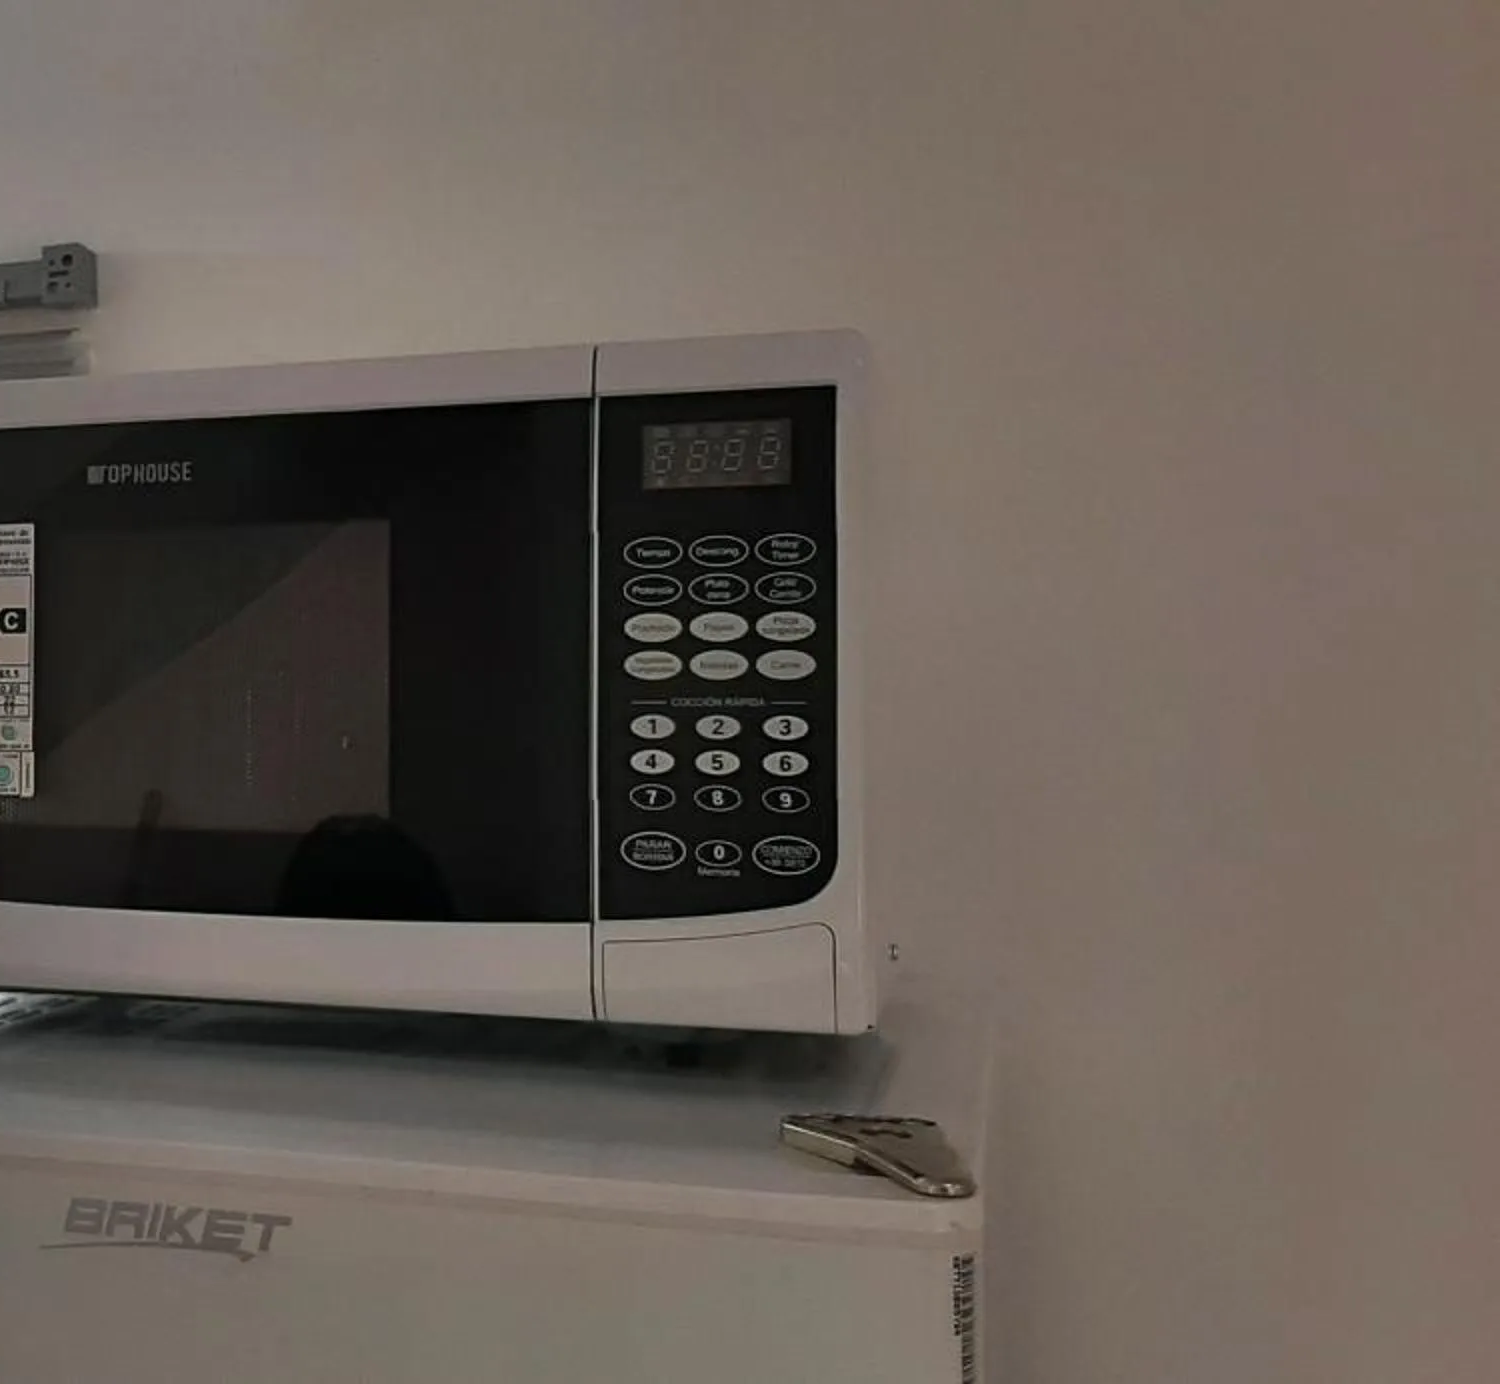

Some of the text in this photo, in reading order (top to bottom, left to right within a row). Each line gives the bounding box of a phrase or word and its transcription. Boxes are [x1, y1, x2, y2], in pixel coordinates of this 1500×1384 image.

[87, 461, 193, 485] TOPHOUSE
[3, 611, 20, 630] C
[648, 719, 657, 735] 1
[712, 719, 725, 735] 2
[779, 719, 792, 736] 3
[645, 754, 657, 769] 4
[711, 754, 724, 771] 5
[779, 755, 792, 772] 6
[645, 790, 658, 805] 7
[711, 790, 724, 806] 8
[779, 792, 793, 808] 9
[713, 845, 725, 860] 0
[64, 1197, 293, 1252] BRIKET
